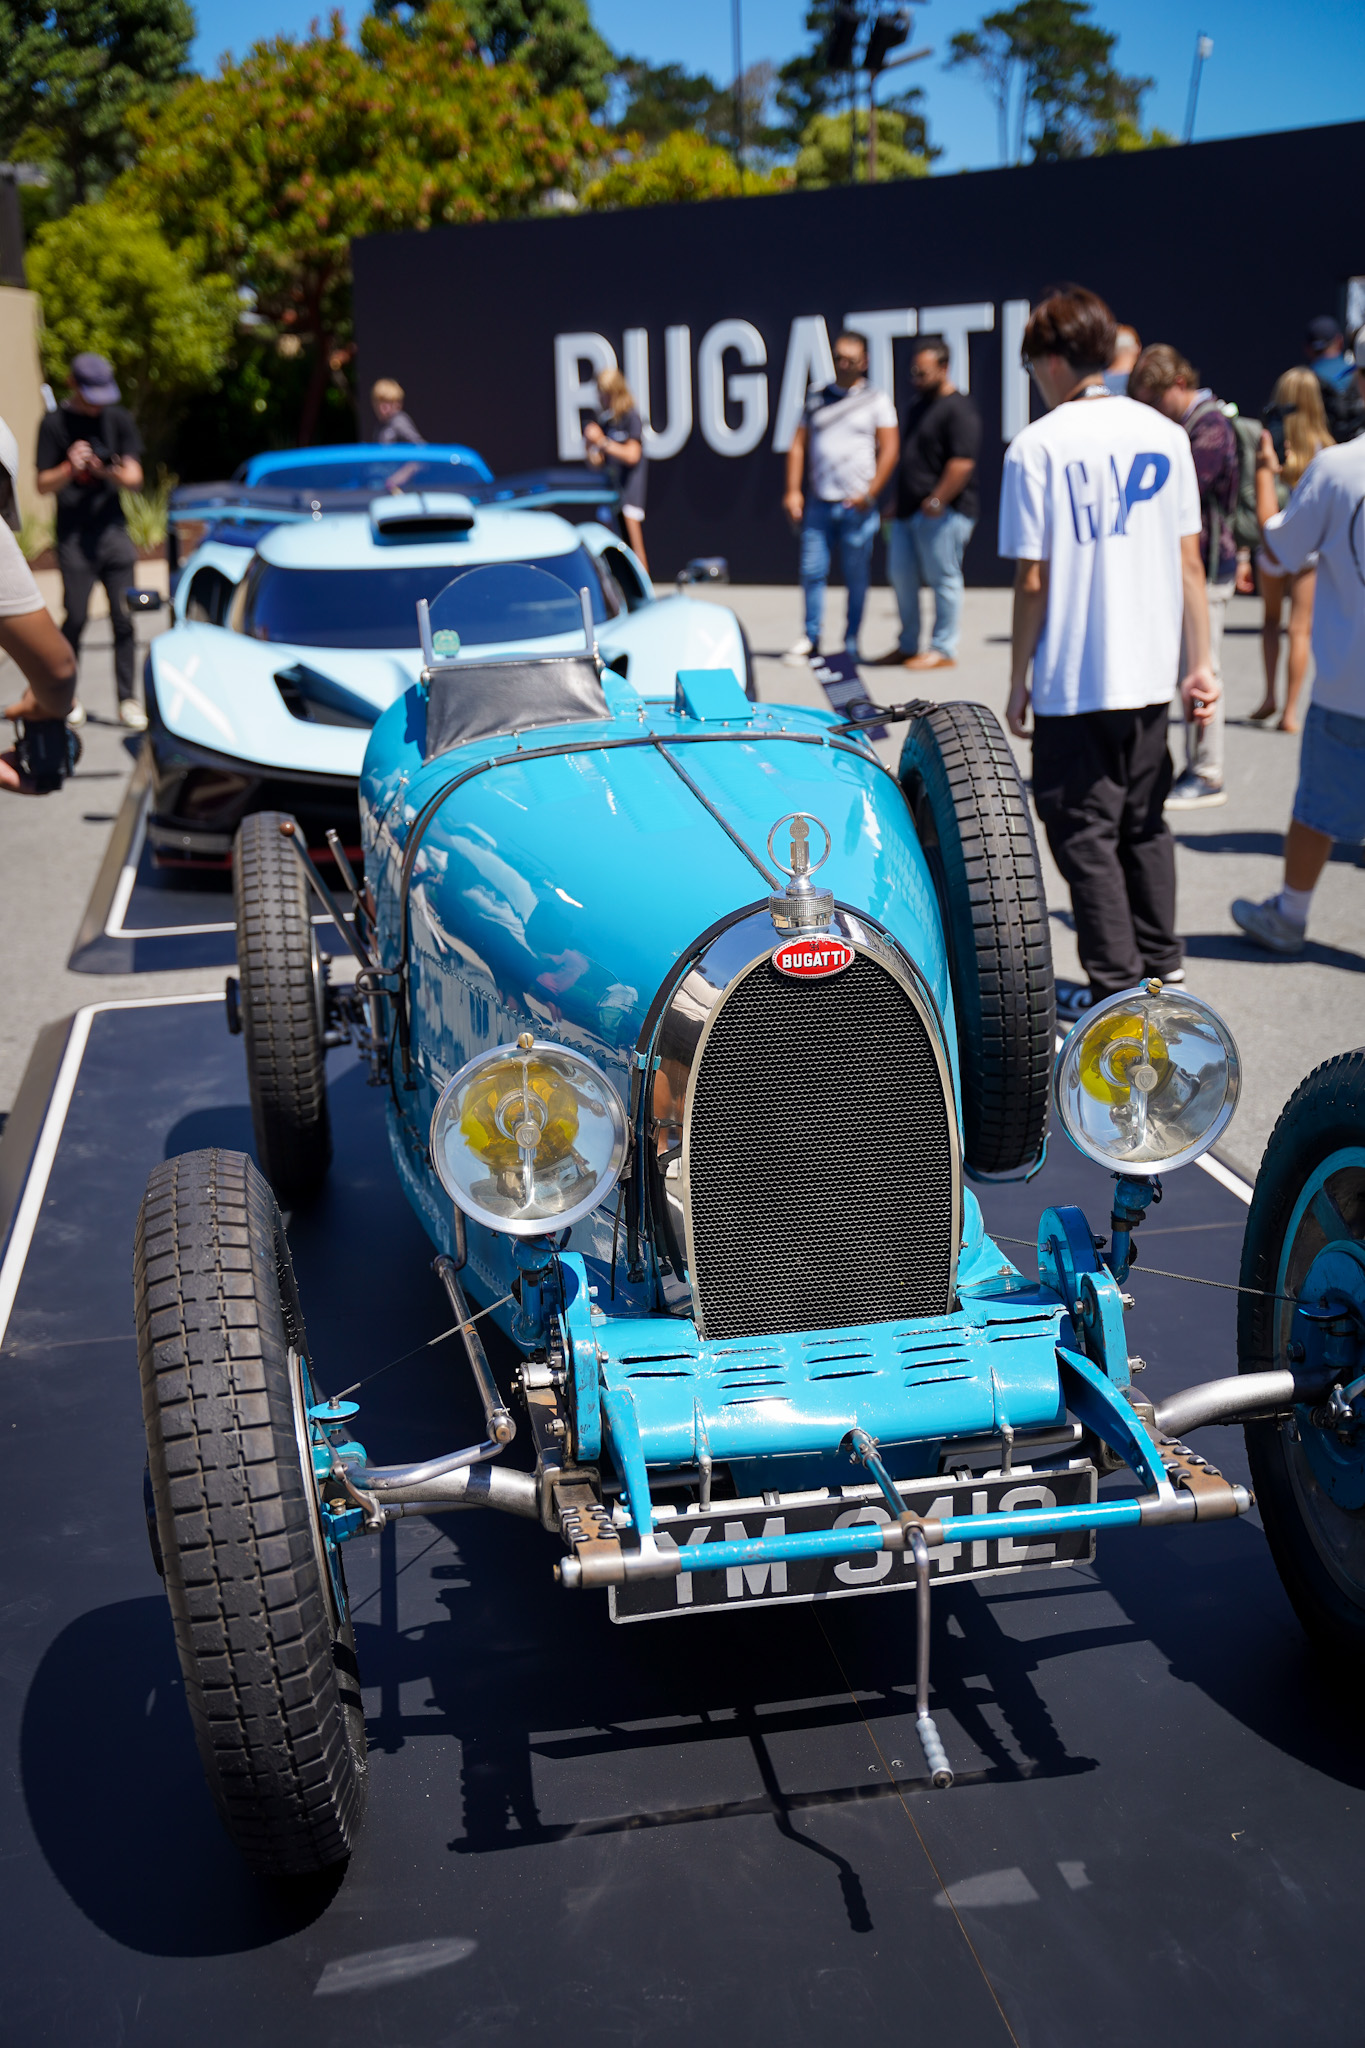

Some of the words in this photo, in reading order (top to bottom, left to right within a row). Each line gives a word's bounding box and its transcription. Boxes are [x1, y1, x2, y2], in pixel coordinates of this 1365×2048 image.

[553, 299, 1032, 463] BUGATTI
[782, 950, 846, 969] BUGATTI
[653, 1516, 788, 1605] YM
